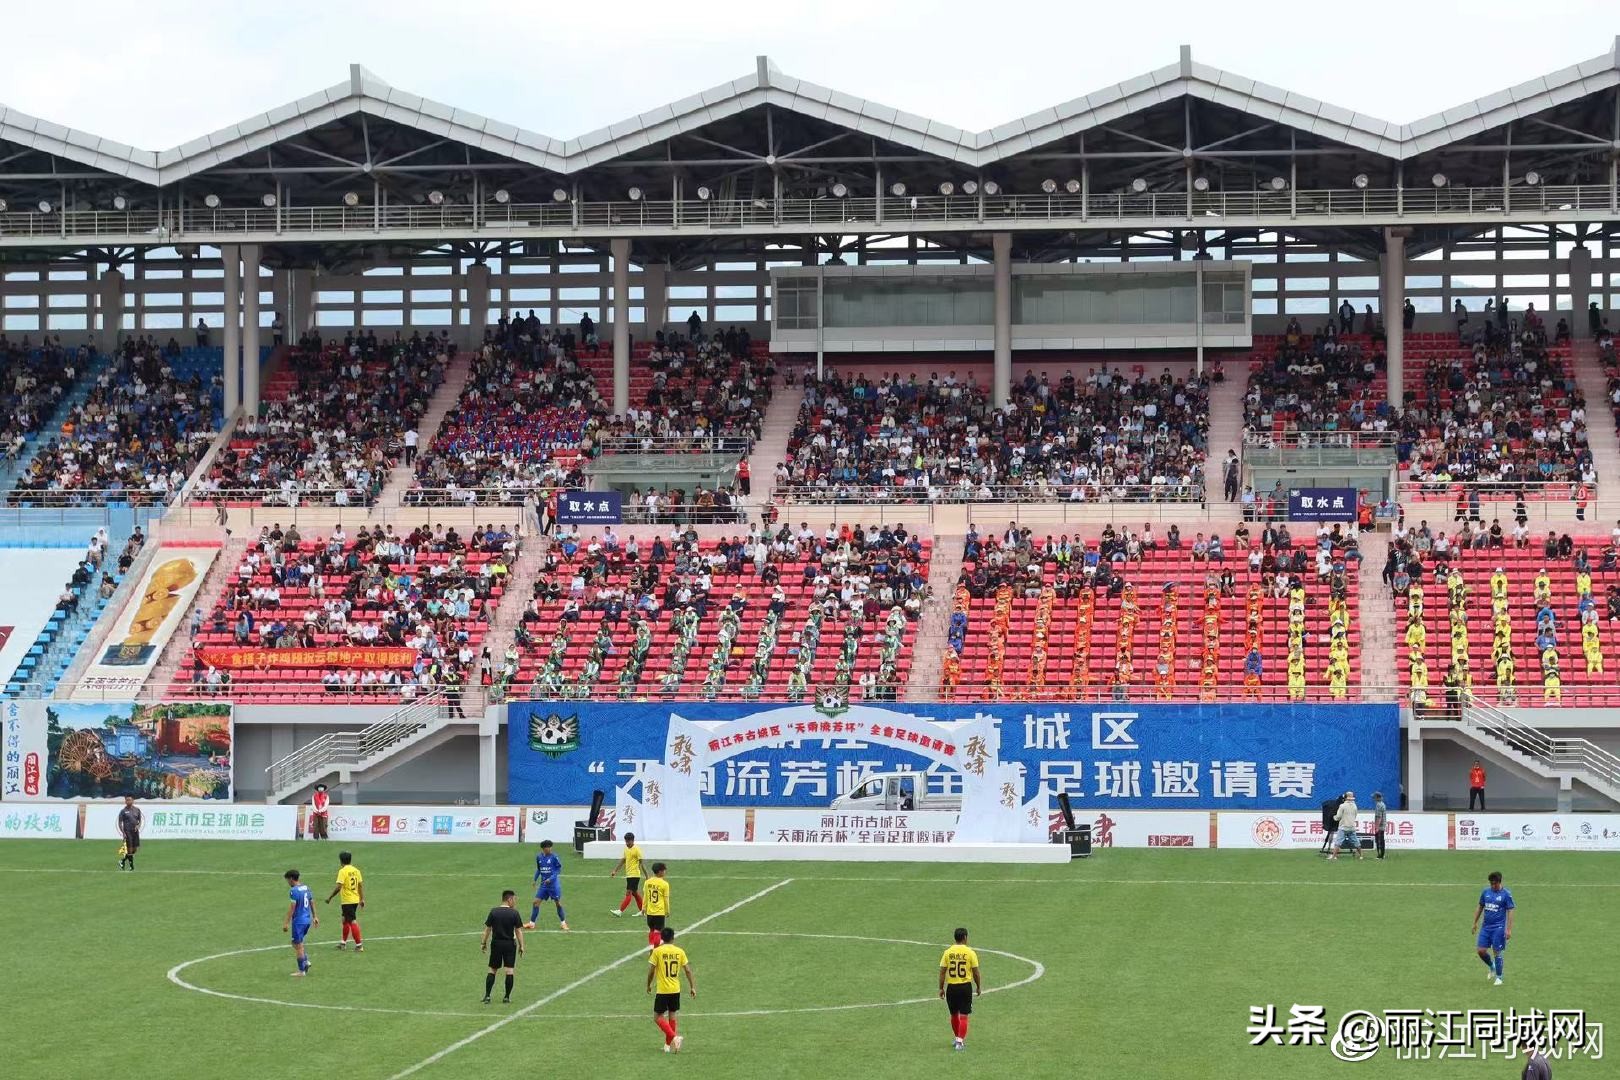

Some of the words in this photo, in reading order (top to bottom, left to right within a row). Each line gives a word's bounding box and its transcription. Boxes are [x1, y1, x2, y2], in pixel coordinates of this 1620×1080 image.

[569, 500, 610, 512] 取水点
[1301, 496, 1344, 509] 取水点
[5, 702, 20, 795] 舍不得的丽江
[152, 812, 265, 827] 丽江市足球协会
[820, 815, 908, 829] 丽江市古城区
[303, 892, 308, 907] 6
[648, 889, 659, 904] 19
[664, 960, 678, 977] 10
[948, 960, 967, 978] 26
